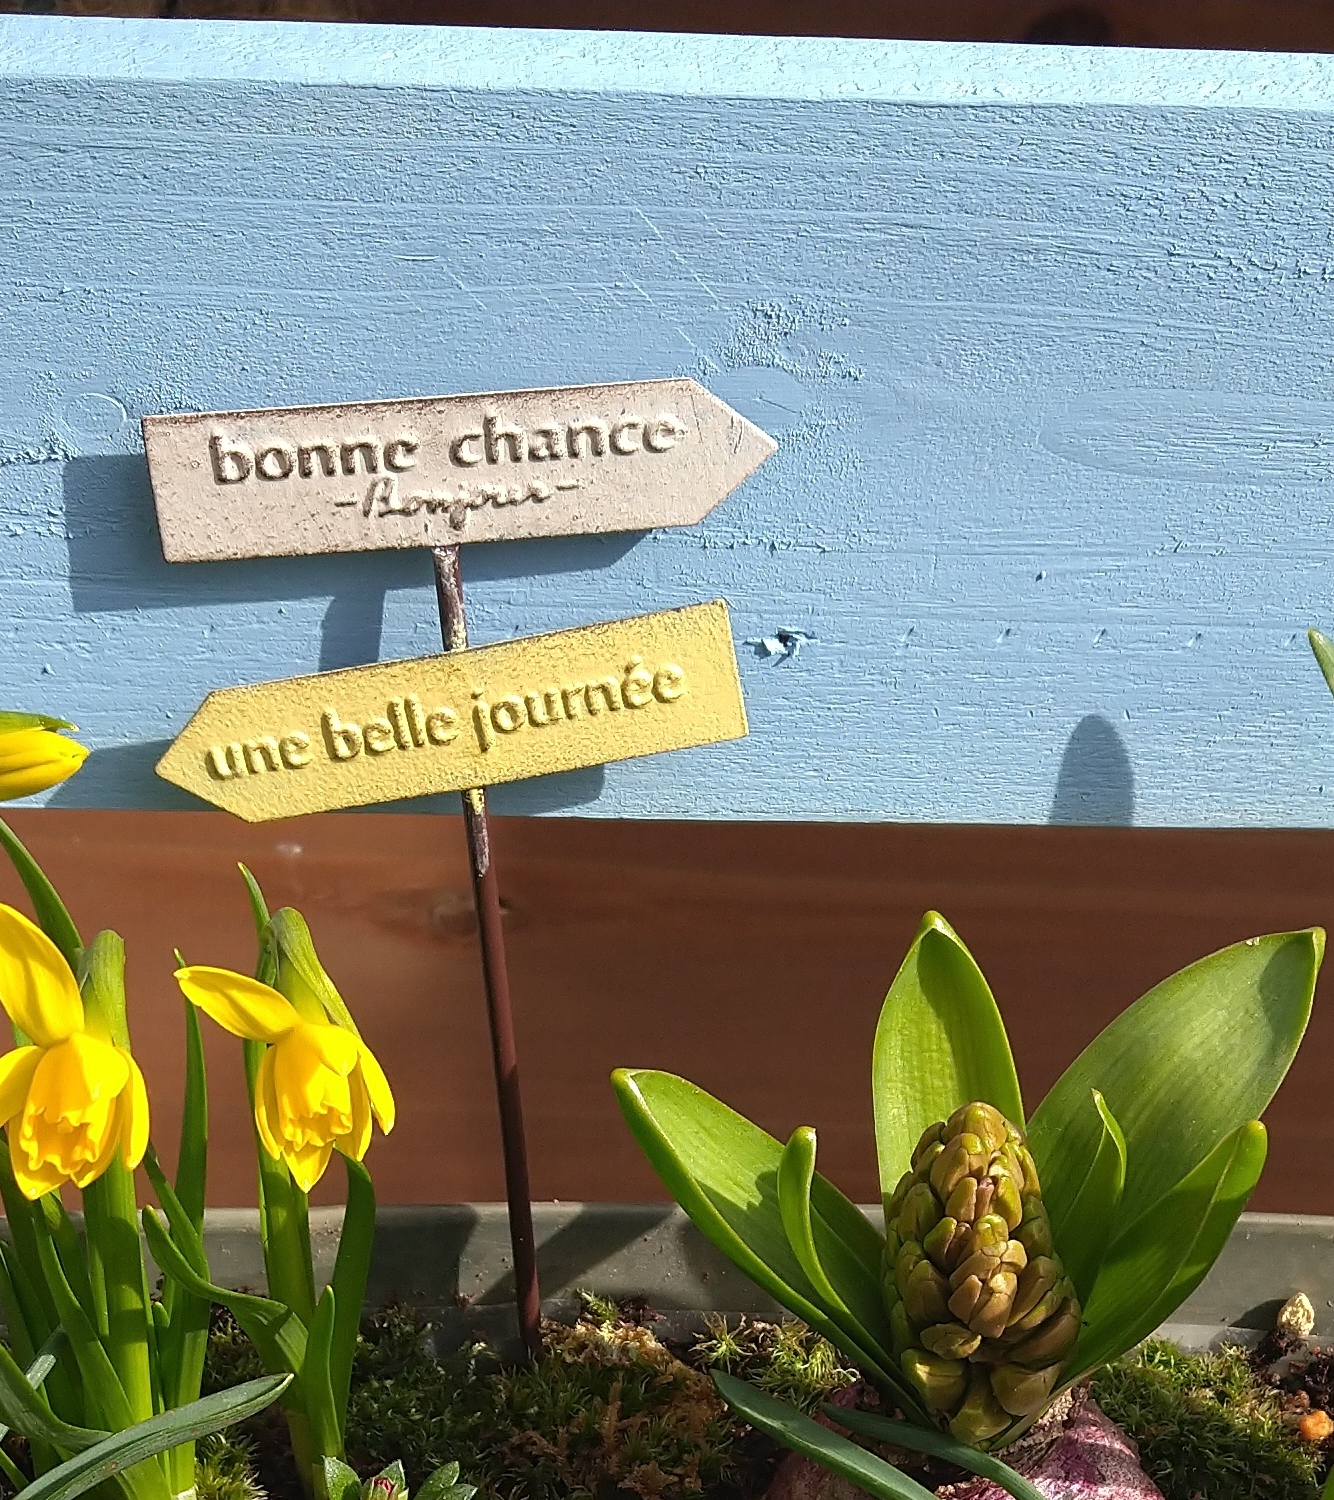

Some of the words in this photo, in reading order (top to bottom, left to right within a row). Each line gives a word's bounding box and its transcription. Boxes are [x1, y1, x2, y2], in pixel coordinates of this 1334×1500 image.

[211, 432, 421, 484] bonne
[451, 408, 686, 465] chance
[206, 731, 311, 782] une
[321, 704, 460, 762] belle
[472, 655, 686, 752] journée
